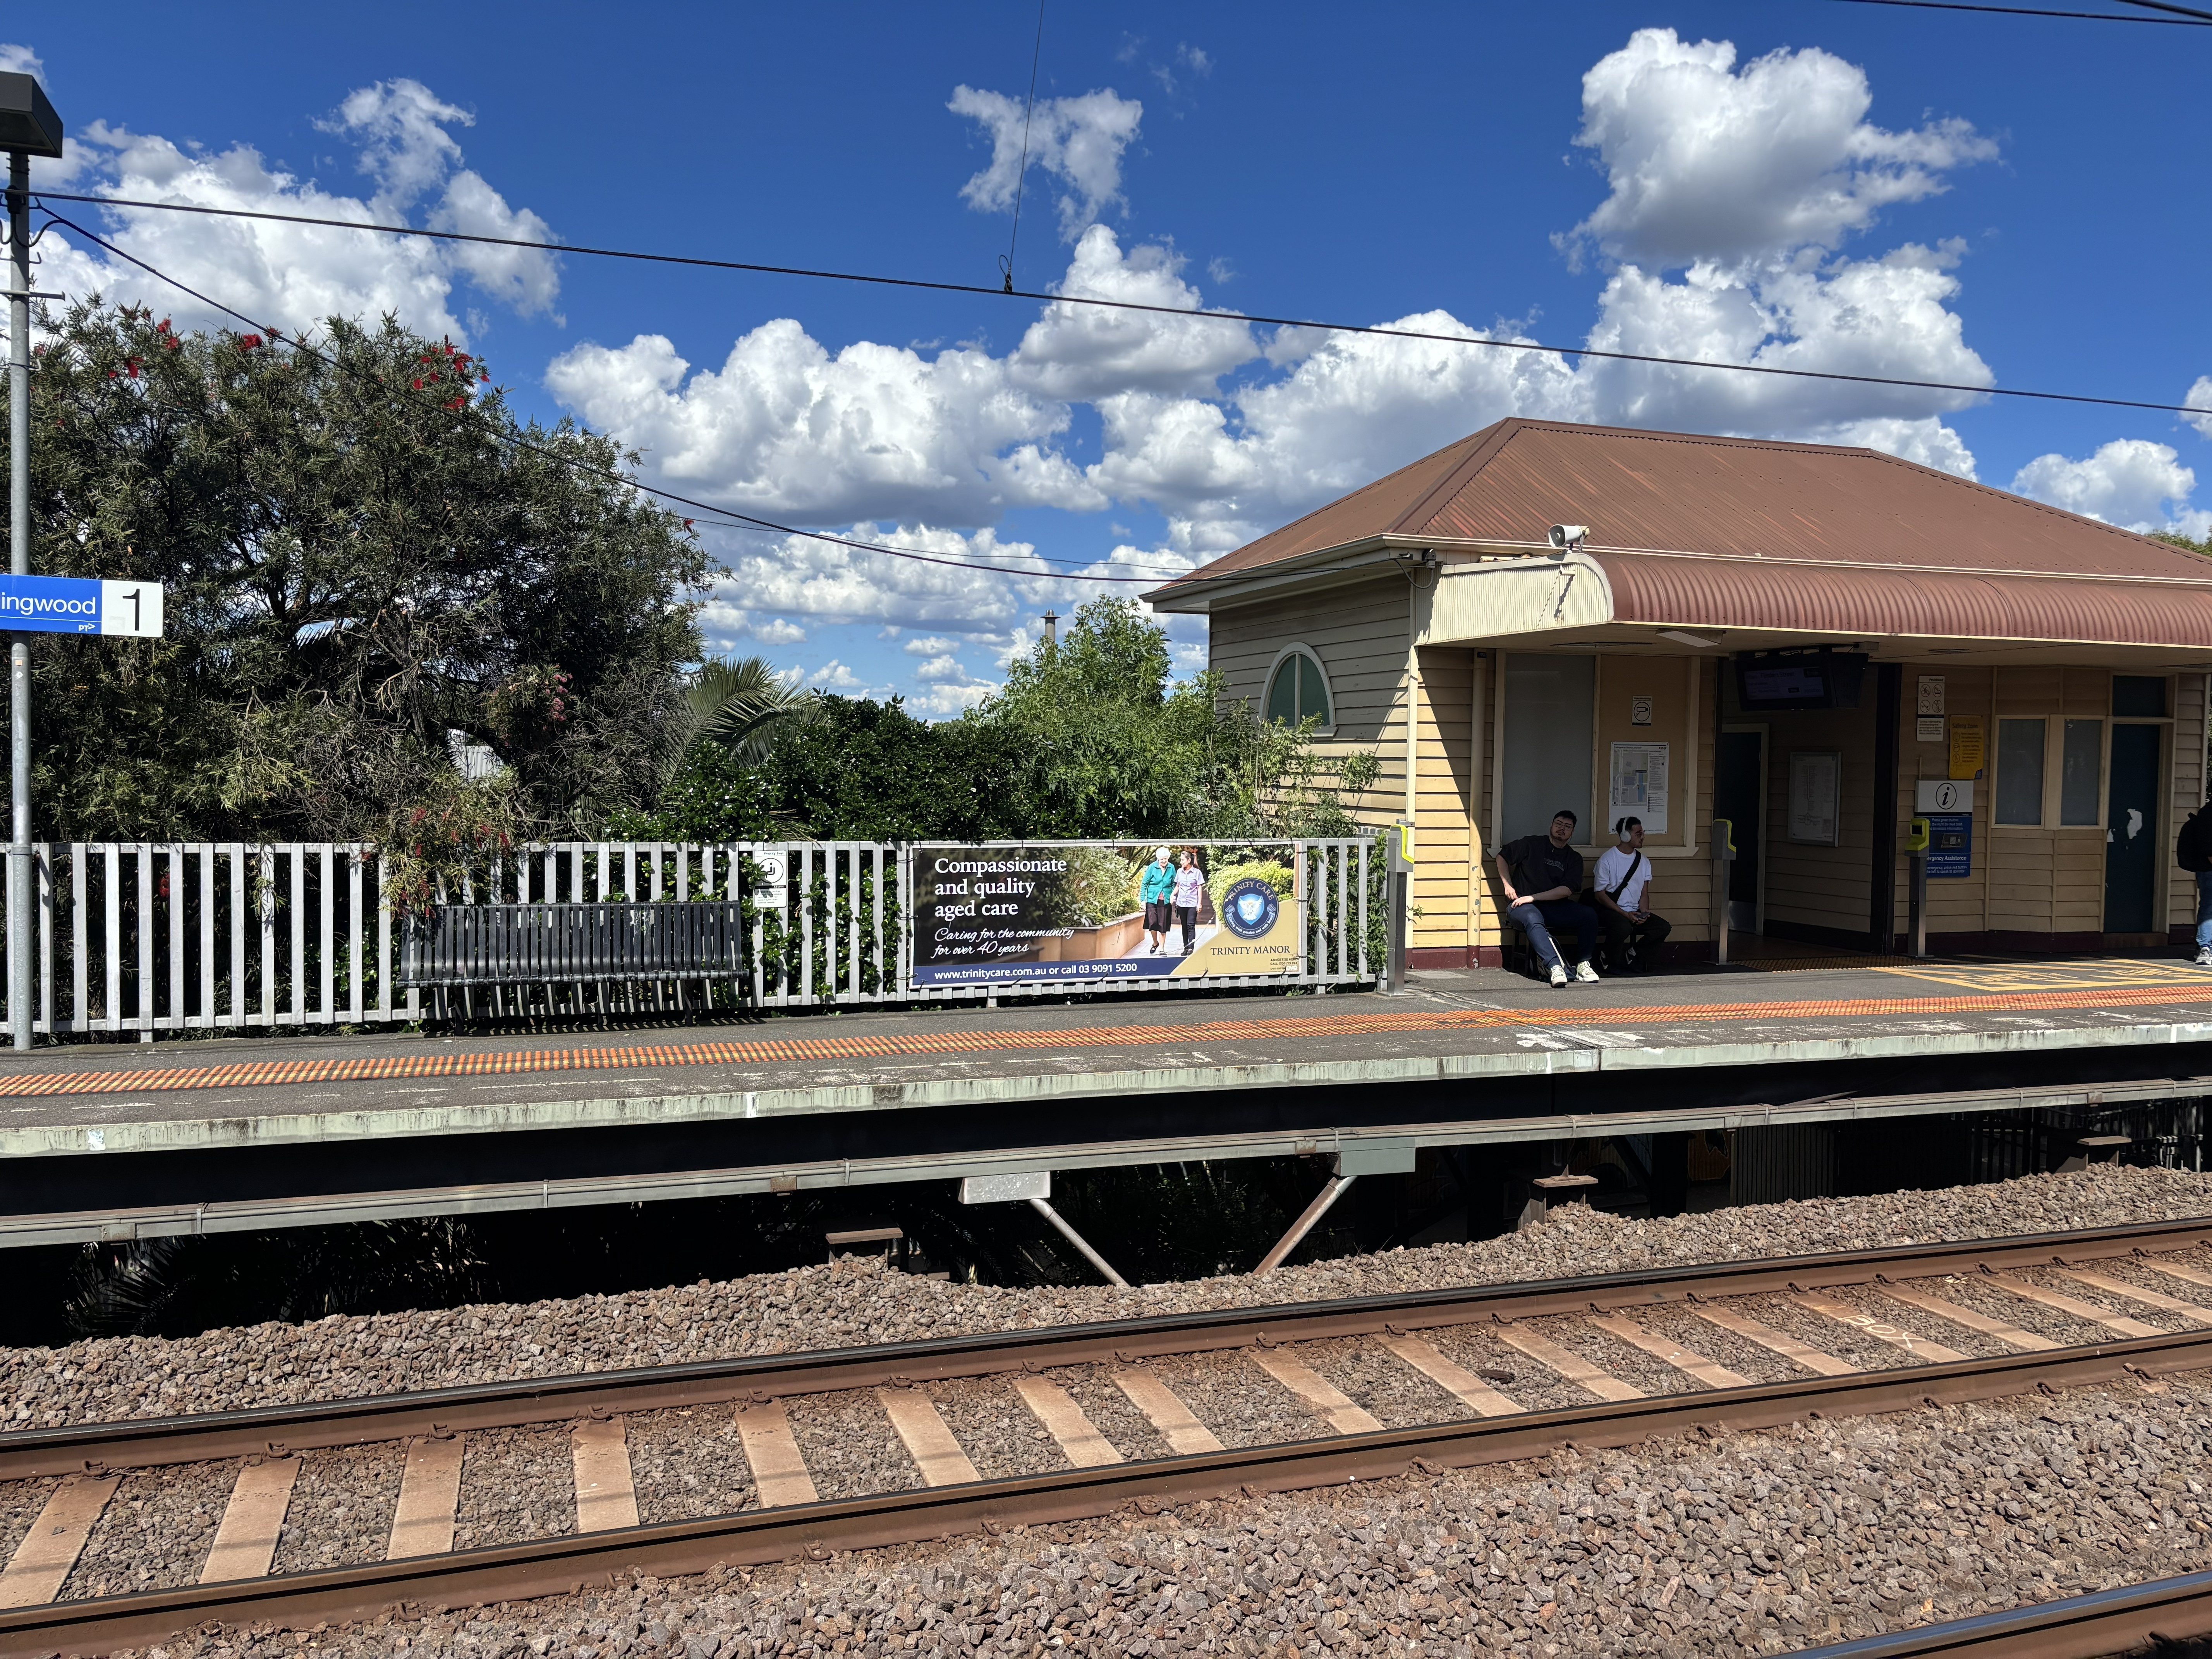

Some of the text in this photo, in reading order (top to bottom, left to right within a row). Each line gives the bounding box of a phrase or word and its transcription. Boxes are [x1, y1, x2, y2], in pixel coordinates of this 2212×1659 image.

[2, 592, 96, 615] ingwood
[122, 588, 140, 631] 1
[935, 857, 1067, 877] Compassionate
[935, 878, 1036, 899] and quality
[1256, 883, 1274, 900] CARE
[935, 900, 1018, 922] aged care
[934, 927, 1074, 942] Caring for the community
[930, 941, 1030, 959] for over 40 years
[1211, 945, 1290, 955] TRINITY MANOR
[935, 968, 1046, 979] www.trinitycare.com.au
[1061, 965, 1077, 974] call
[1078, 965, 1090, 974] 03
[1092, 964, 1114, 973] 9091
[1116, 963, 1137, 972] 5200
[1956, 973, 2078, 982] SAFETY
[1838, 1314, 1926, 1348] BOX
